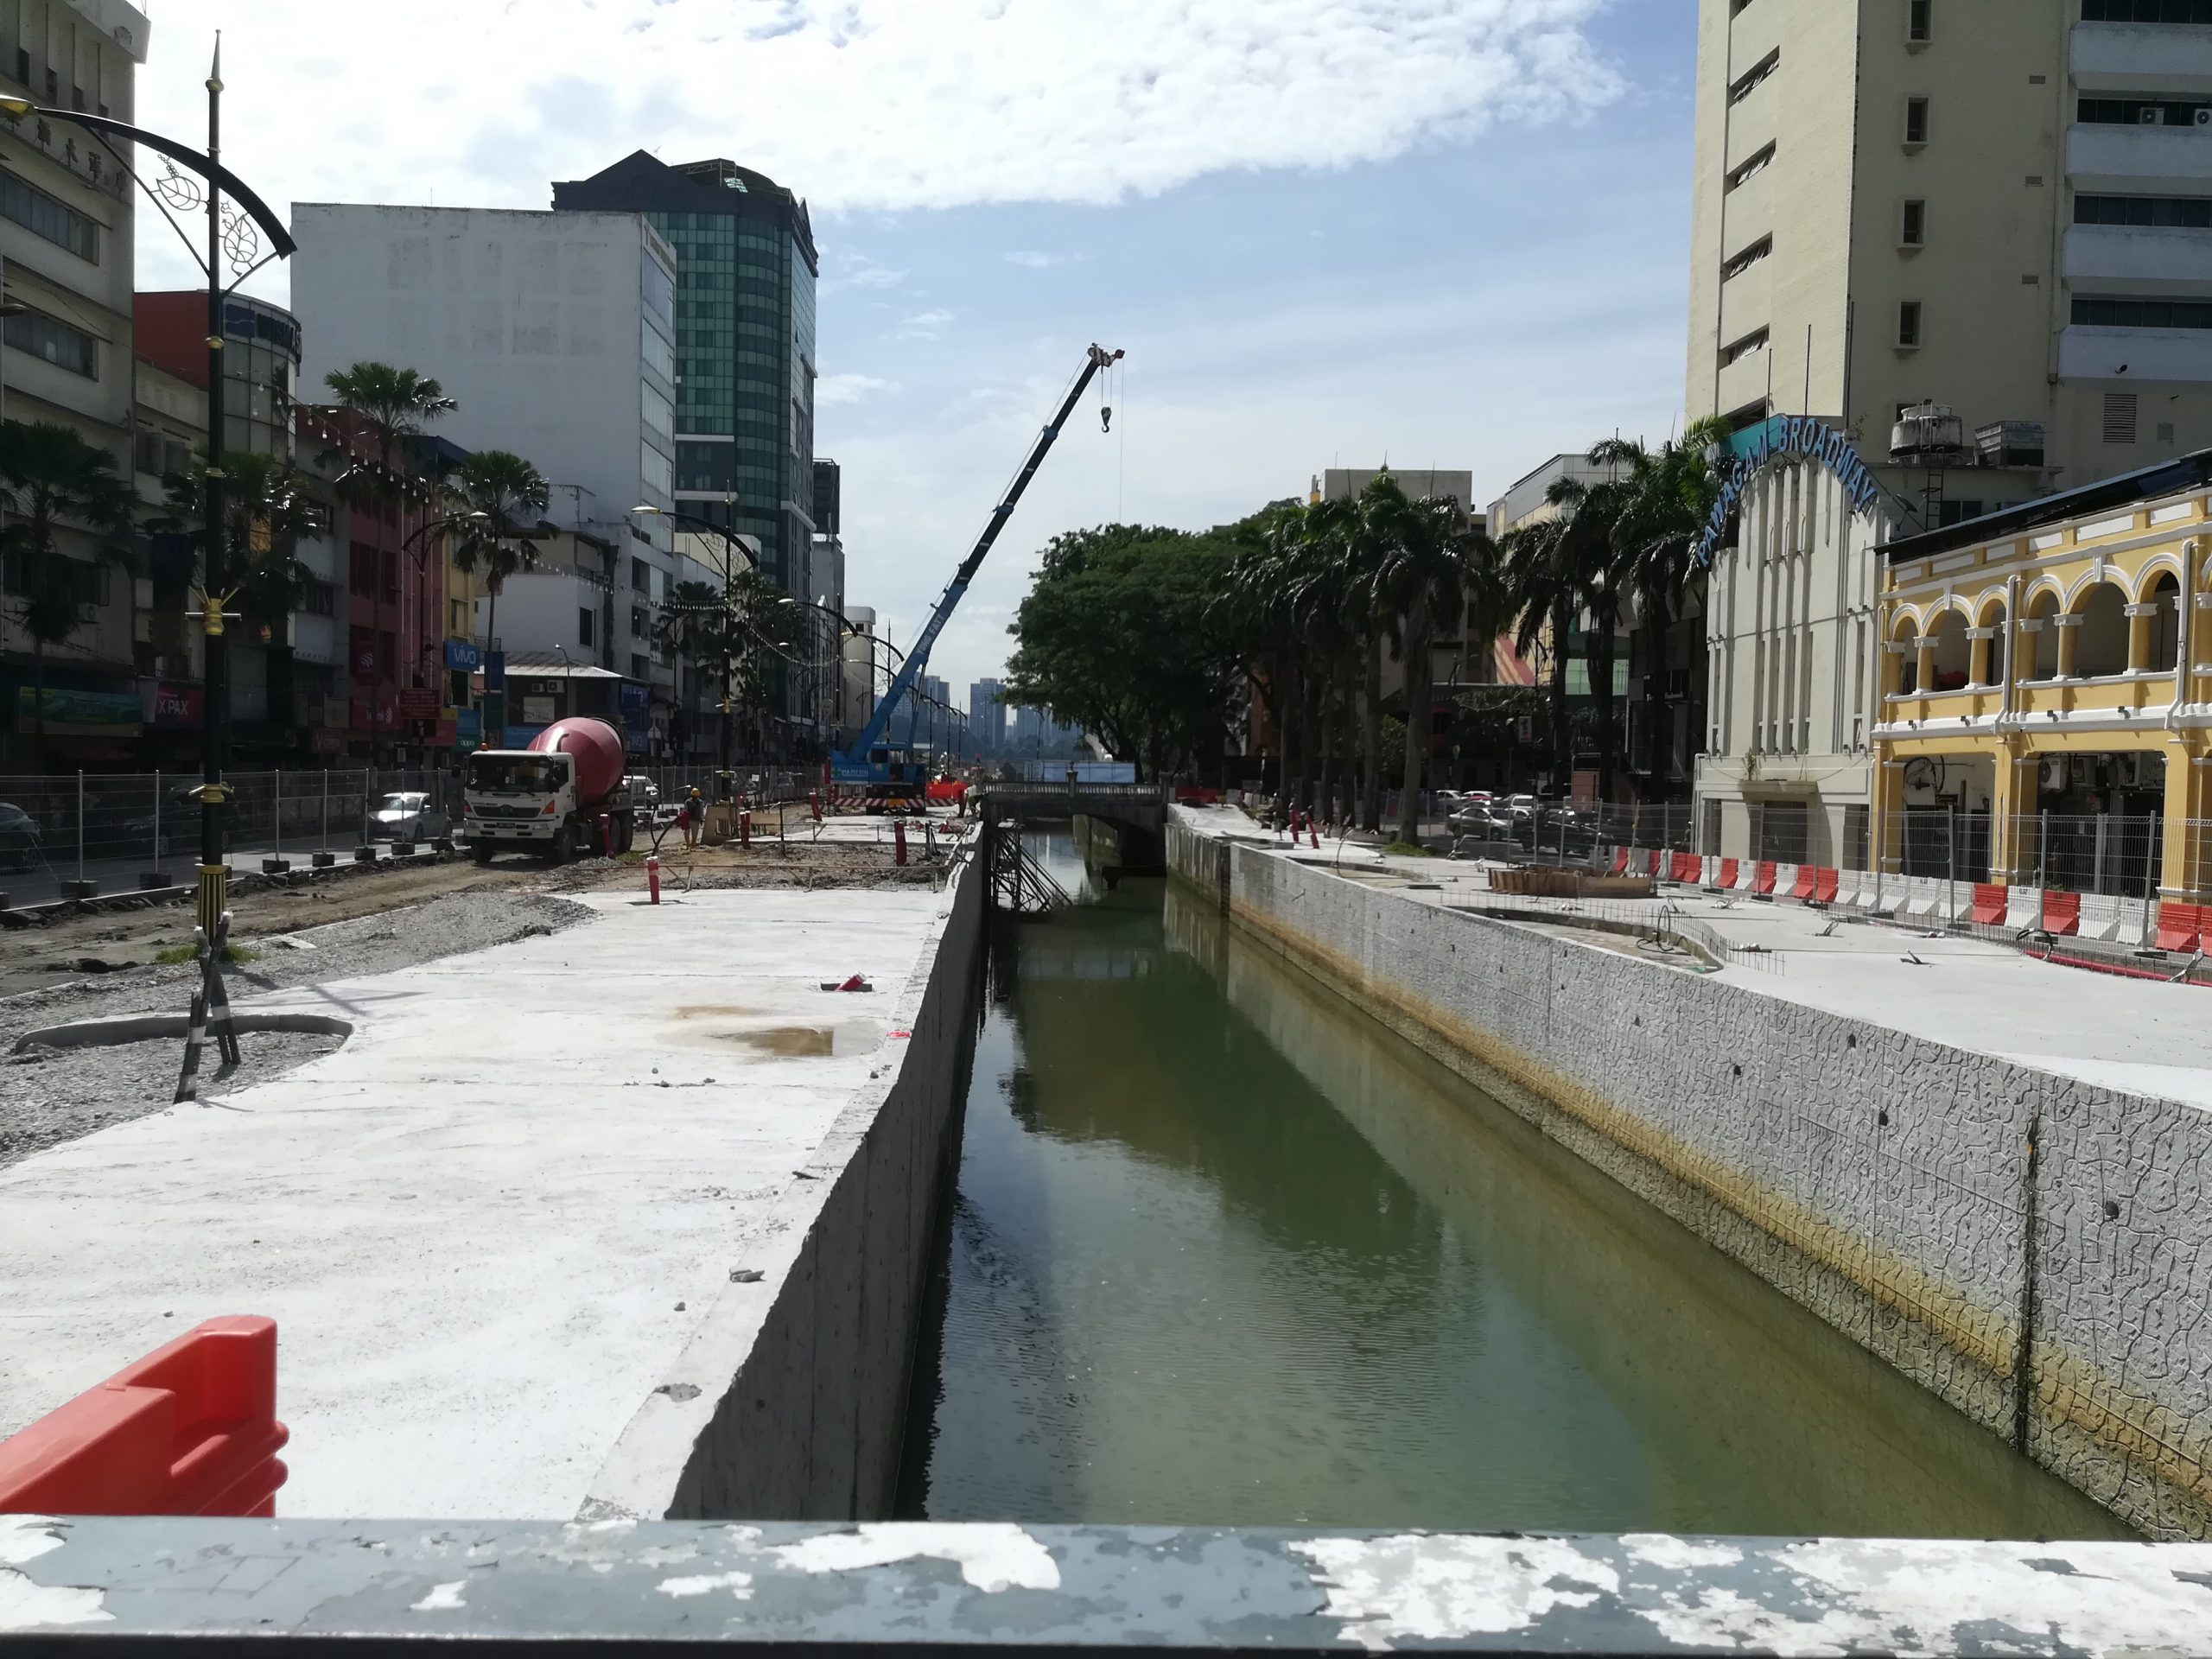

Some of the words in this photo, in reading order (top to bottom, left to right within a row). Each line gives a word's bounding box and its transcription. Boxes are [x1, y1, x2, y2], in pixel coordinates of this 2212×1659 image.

[1696, 432, 1770, 568] PAWAGAM
[1778, 416, 1878, 514] BROADWAY
[928, 613, 945, 634] FATT
